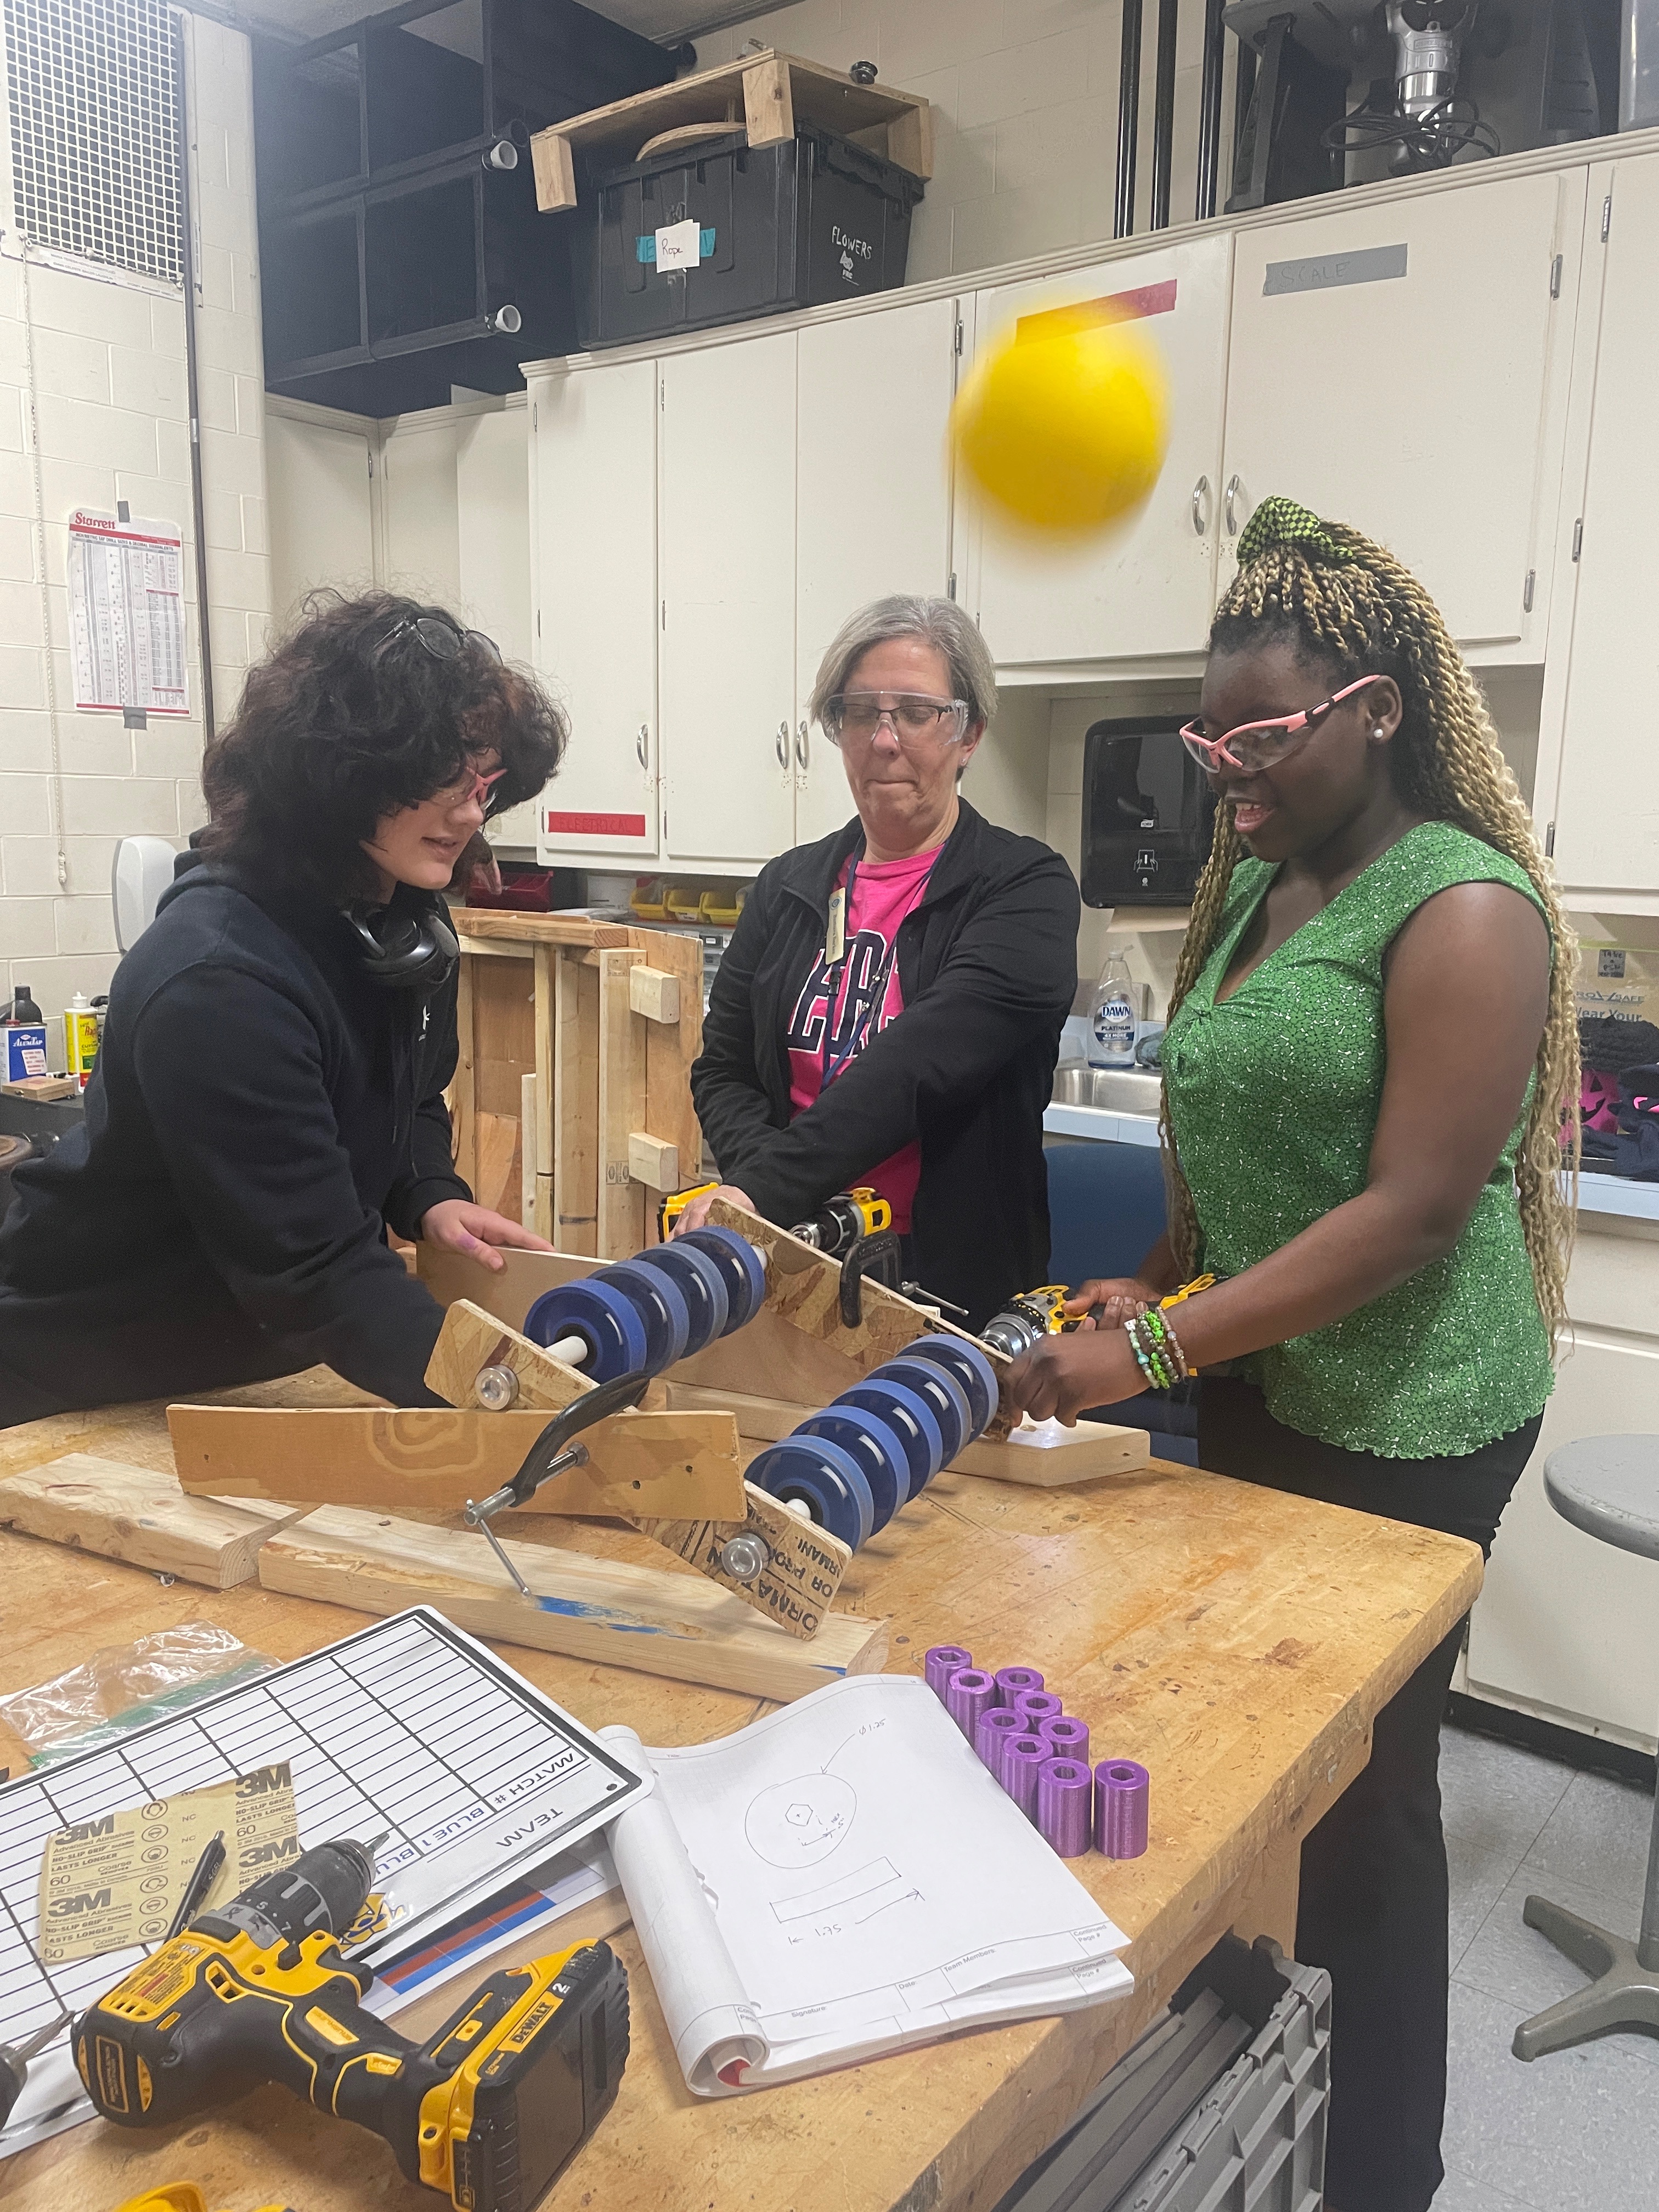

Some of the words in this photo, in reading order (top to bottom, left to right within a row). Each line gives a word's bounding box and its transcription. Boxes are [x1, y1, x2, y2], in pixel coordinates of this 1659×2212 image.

[661, 238, 683, 259] Rope
[832, 225, 872, 259] FLOWERS
[75, 511, 116, 529] Starrett
[1103, 1006, 1131, 1017] DAWN
[235, 1763, 292, 1798] 3M
[510, 1753, 575, 1796] MATCH
[235, 1792, 273, 1807] Advanced
[494, 1793, 507, 1804] #
[236, 1803, 267, 1815] NO-SLIP
[236, 1812, 262, 1824] LASTS
[432, 1807, 484, 1840] BLUE
[55, 1814, 114, 1846] 3M
[236, 1824, 256, 1837] 60
[495, 1808, 564, 1848] TEAM
[53, 1840, 94, 1854] Advanced
[95, 1830, 135, 1843] Abrasives
[52, 1851, 86, 1863] NO-SLIP
[238, 1835, 298, 1868] 3M
[52, 1861, 80, 1872] LASTS
[82, 1853, 117, 1865] LONGER
[98, 1860, 132, 1872] Coarse
[239, 1860, 279, 1876] Advanced
[50, 1874, 71, 1886] 60
[47, 1887, 111, 1917] 3M
[256, 1901, 268, 1910] 5
[46, 1912, 89, 1923] Advanced
[91, 1903, 132, 1916] Abrasives
[46, 1924, 80, 1933] NO-SLIP
[76, 1925, 114, 1939] LONGER
[815, 1923, 842, 1937] 1.75
[1073, 1924, 1107, 1937] Continued
[93, 1934, 129, 1946] Coarse
[1078, 1934, 1096, 1943] Page
[944, 1960, 963, 1973] Team
[962, 1948, 997, 1964] Members:
[1072, 1958, 1107, 1973] Continued
[1076, 1971, 1095, 1979] Page
[898, 1980, 918, 1990] Date:
[791, 2005, 827, 2018] Signature:
[510, 2001, 552, 2044] DEWALT
